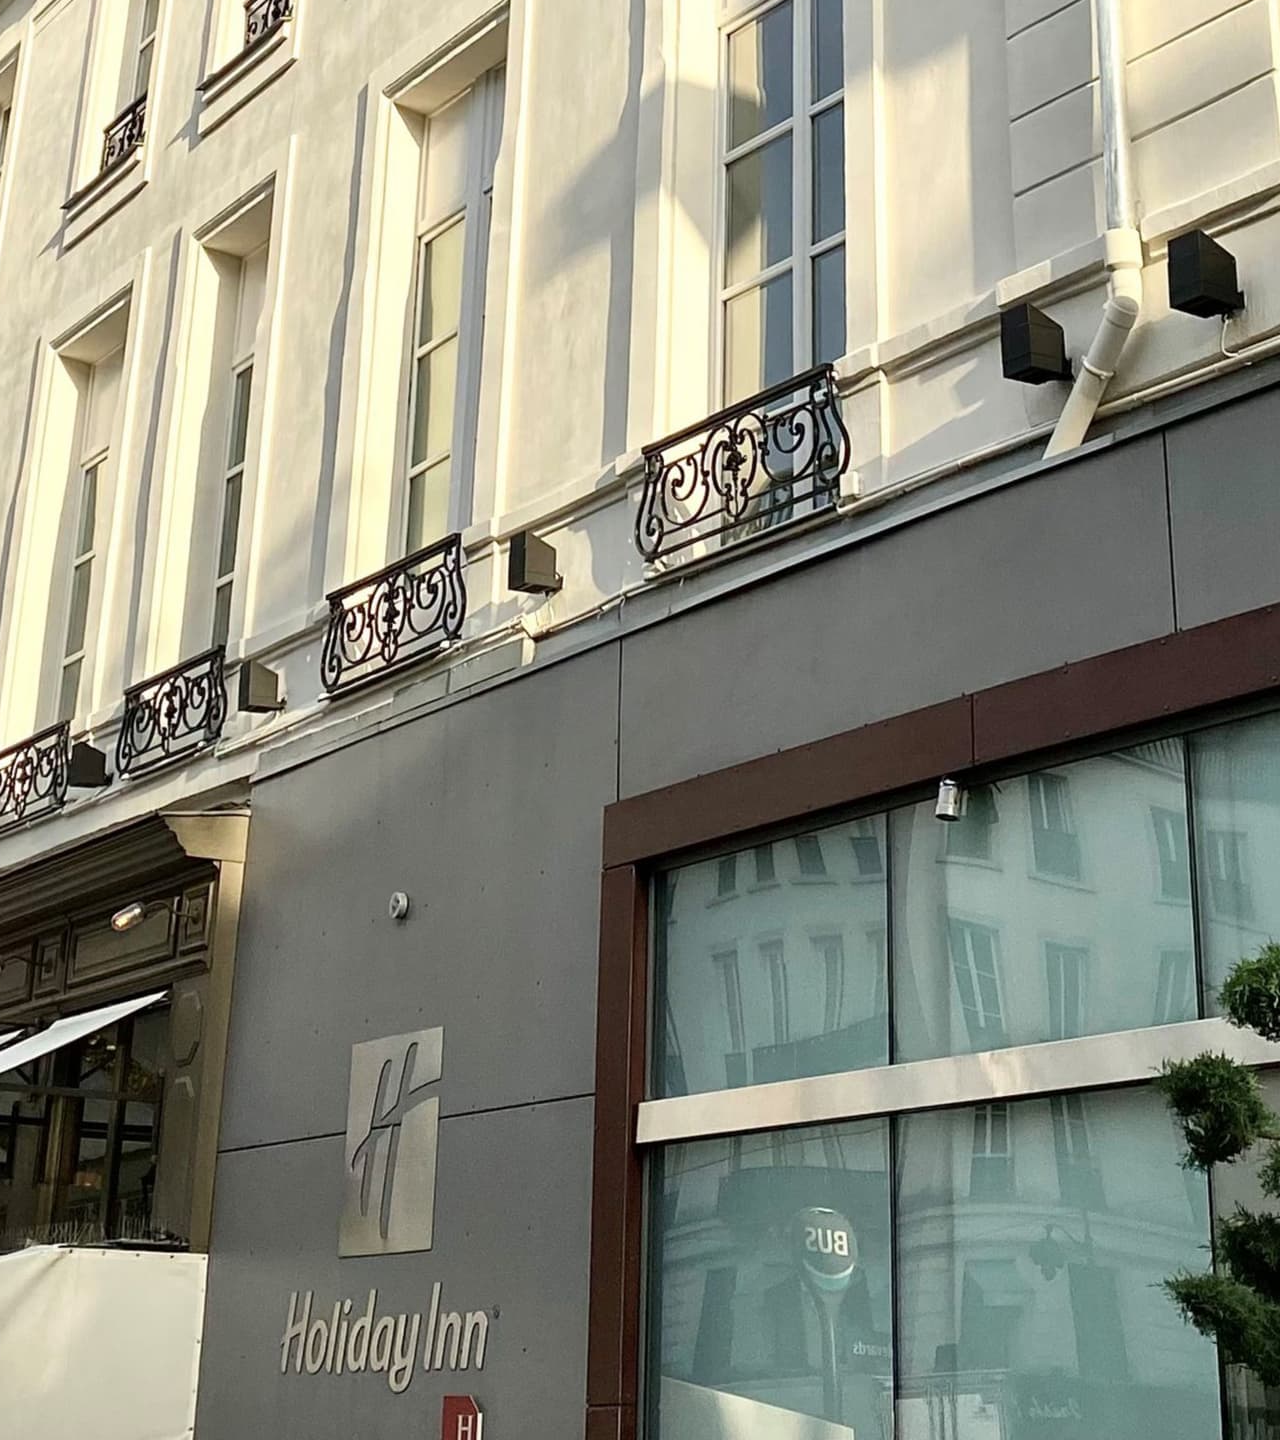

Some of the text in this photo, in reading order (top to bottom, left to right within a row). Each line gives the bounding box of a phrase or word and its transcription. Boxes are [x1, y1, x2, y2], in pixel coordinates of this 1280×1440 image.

[280, 1281, 489, 1393] Holiday Inn
[456, 1414, 474, 1440] H
